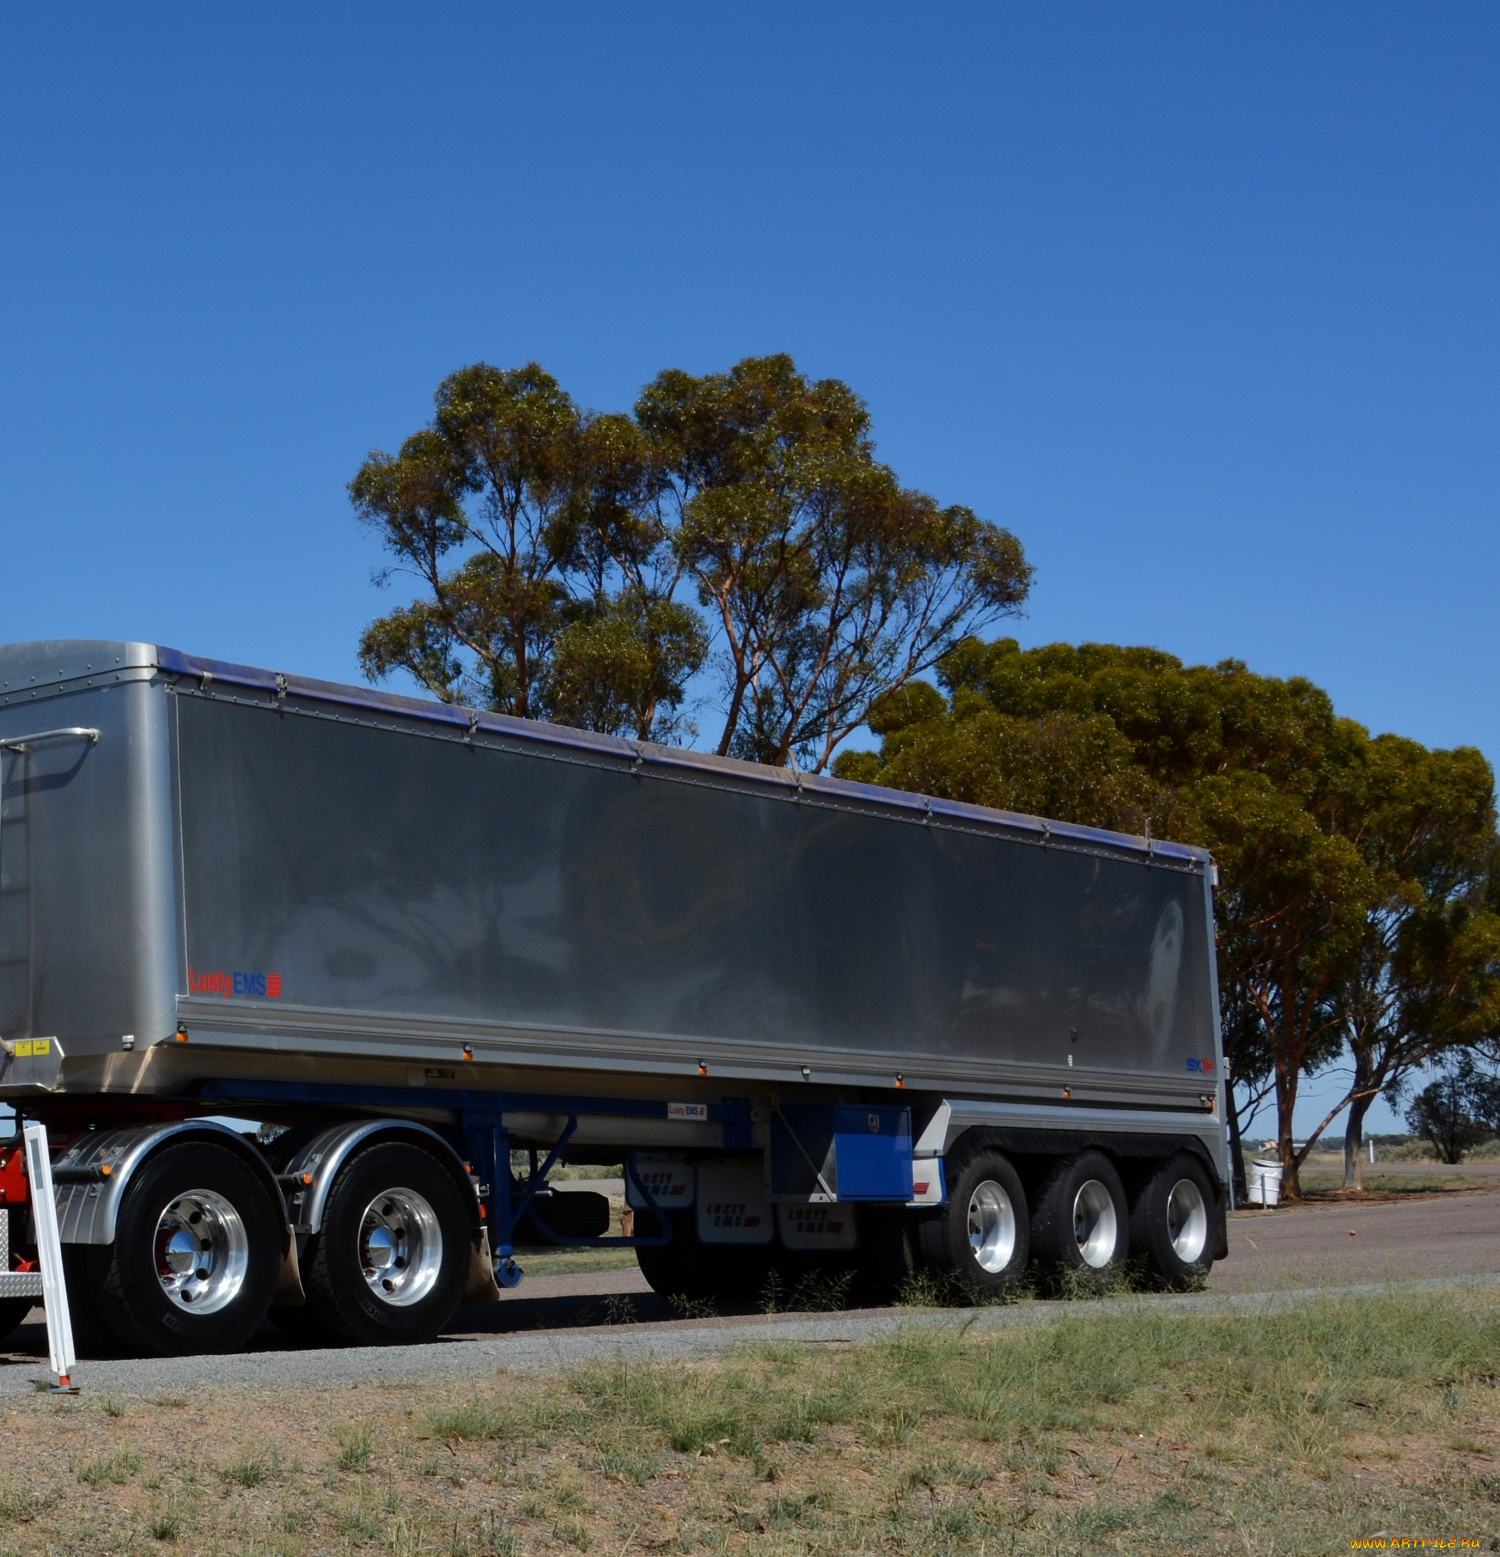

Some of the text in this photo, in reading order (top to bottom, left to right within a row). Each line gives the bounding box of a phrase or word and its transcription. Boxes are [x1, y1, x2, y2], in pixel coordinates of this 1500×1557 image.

[639, 1173, 673, 1184] USTY
[706, 1203, 746, 1215] LUSTY
[788, 1209, 828, 1221] LUSTY
[714, 1216, 742, 1227] EMS
[797, 1222, 825, 1233] EMS
